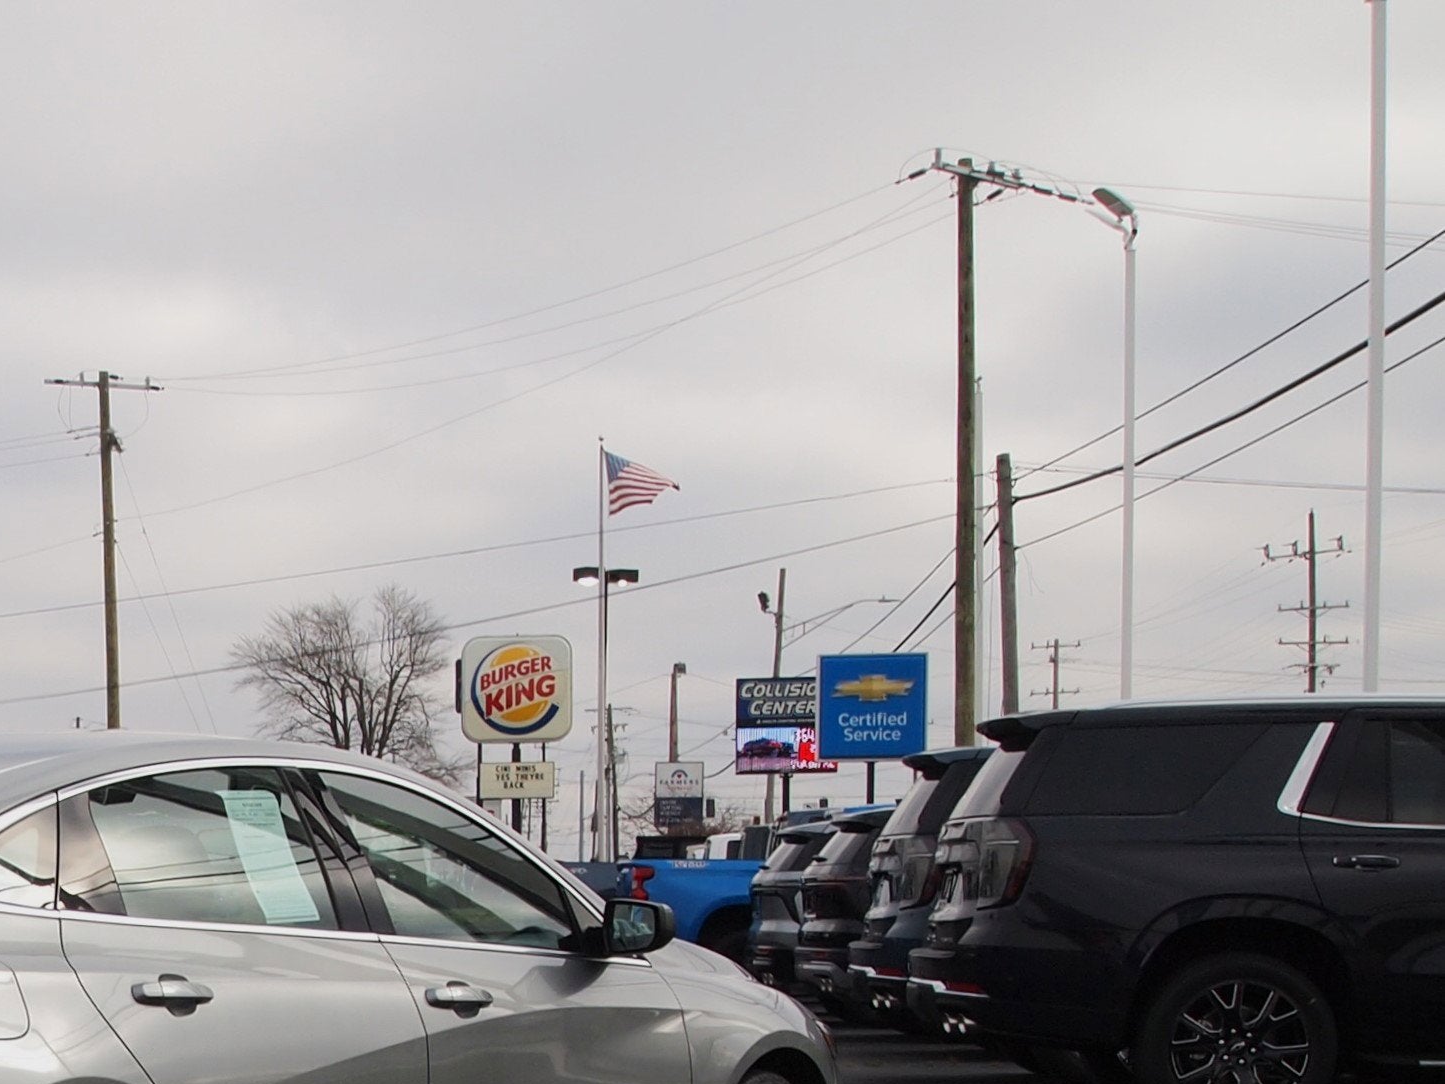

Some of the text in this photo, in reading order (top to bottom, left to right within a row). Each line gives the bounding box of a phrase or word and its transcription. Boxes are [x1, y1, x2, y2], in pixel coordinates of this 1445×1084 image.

[480, 655, 552, 692] BURGER
[484, 674, 556, 718] KING
[741, 682, 816, 698] COLLISIO
[750, 700, 816, 715] CENTER
[837, 711, 908, 727] Certified
[843, 728, 902, 742] Service
[495, 773, 510, 781] YES
[503, 781, 524, 789] BACK
